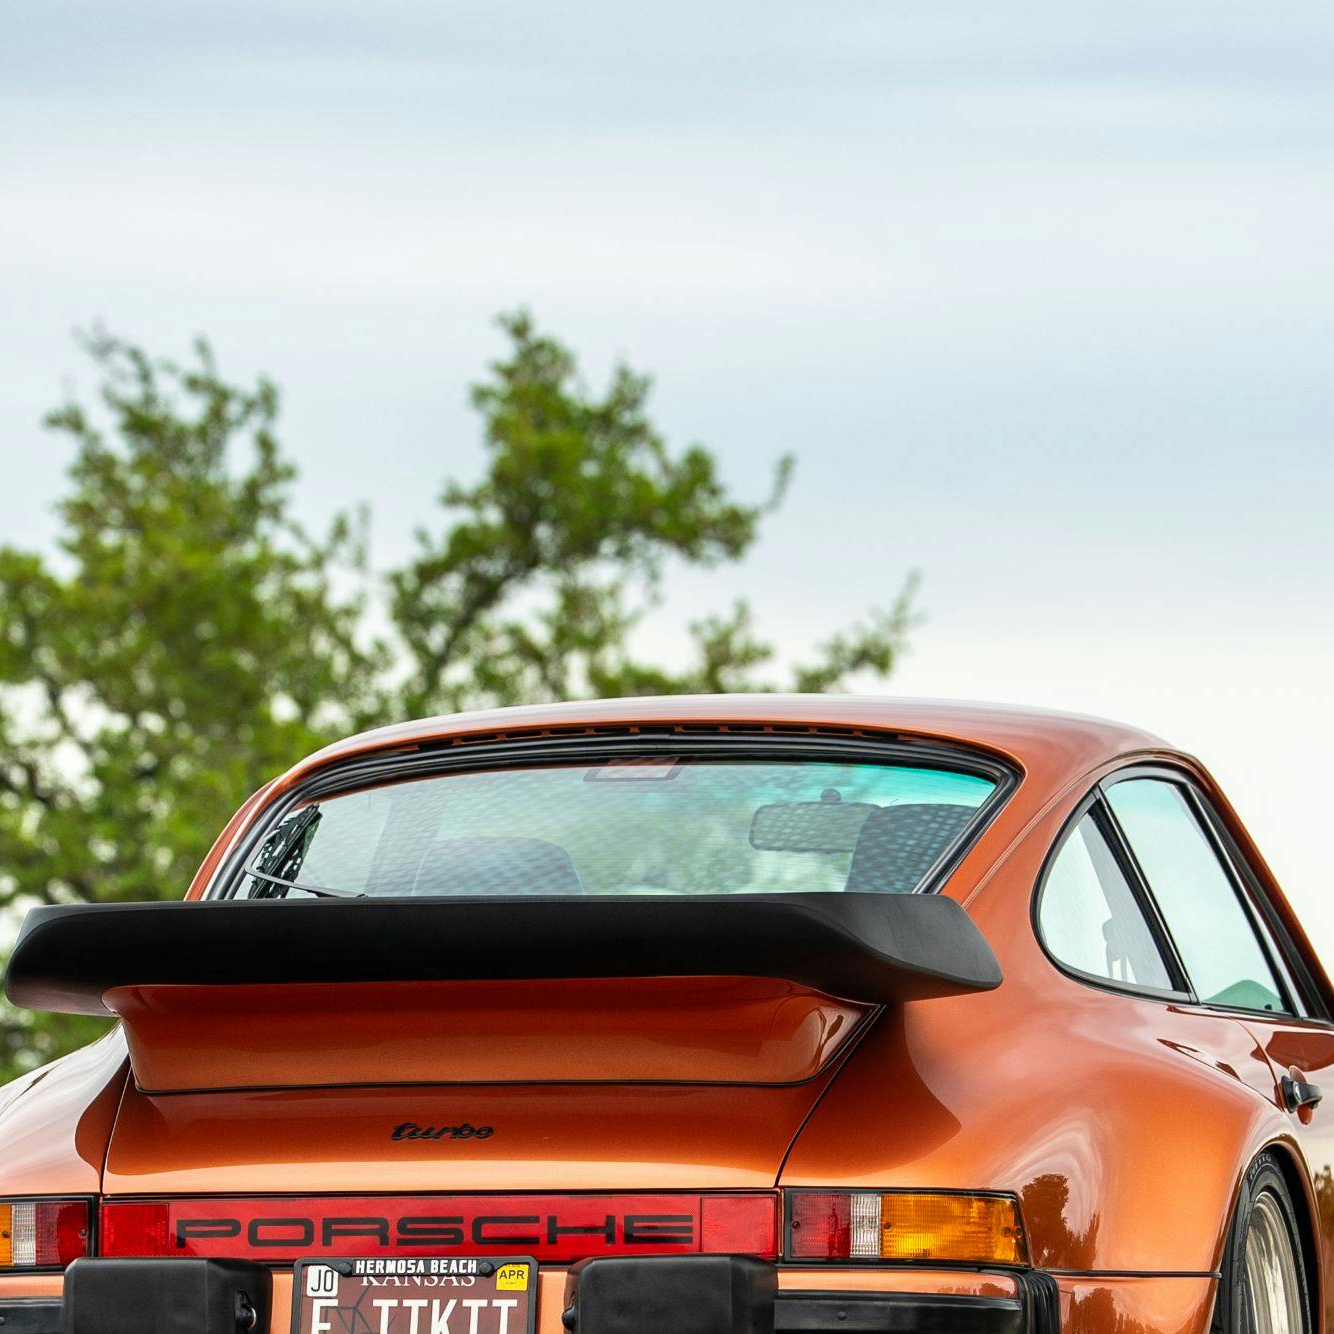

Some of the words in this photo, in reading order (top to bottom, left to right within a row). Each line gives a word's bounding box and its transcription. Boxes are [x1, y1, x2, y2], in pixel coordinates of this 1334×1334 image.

[391, 1123, 494, 1141] turbo
[176, 1215, 694, 1249] PORSCHE
[355, 1259, 425, 1274] HERMOSA
[430, 1259, 477, 1274] BEACH
[498, 1269, 525, 1280] APR
[310, 1269, 334, 1292] JO
